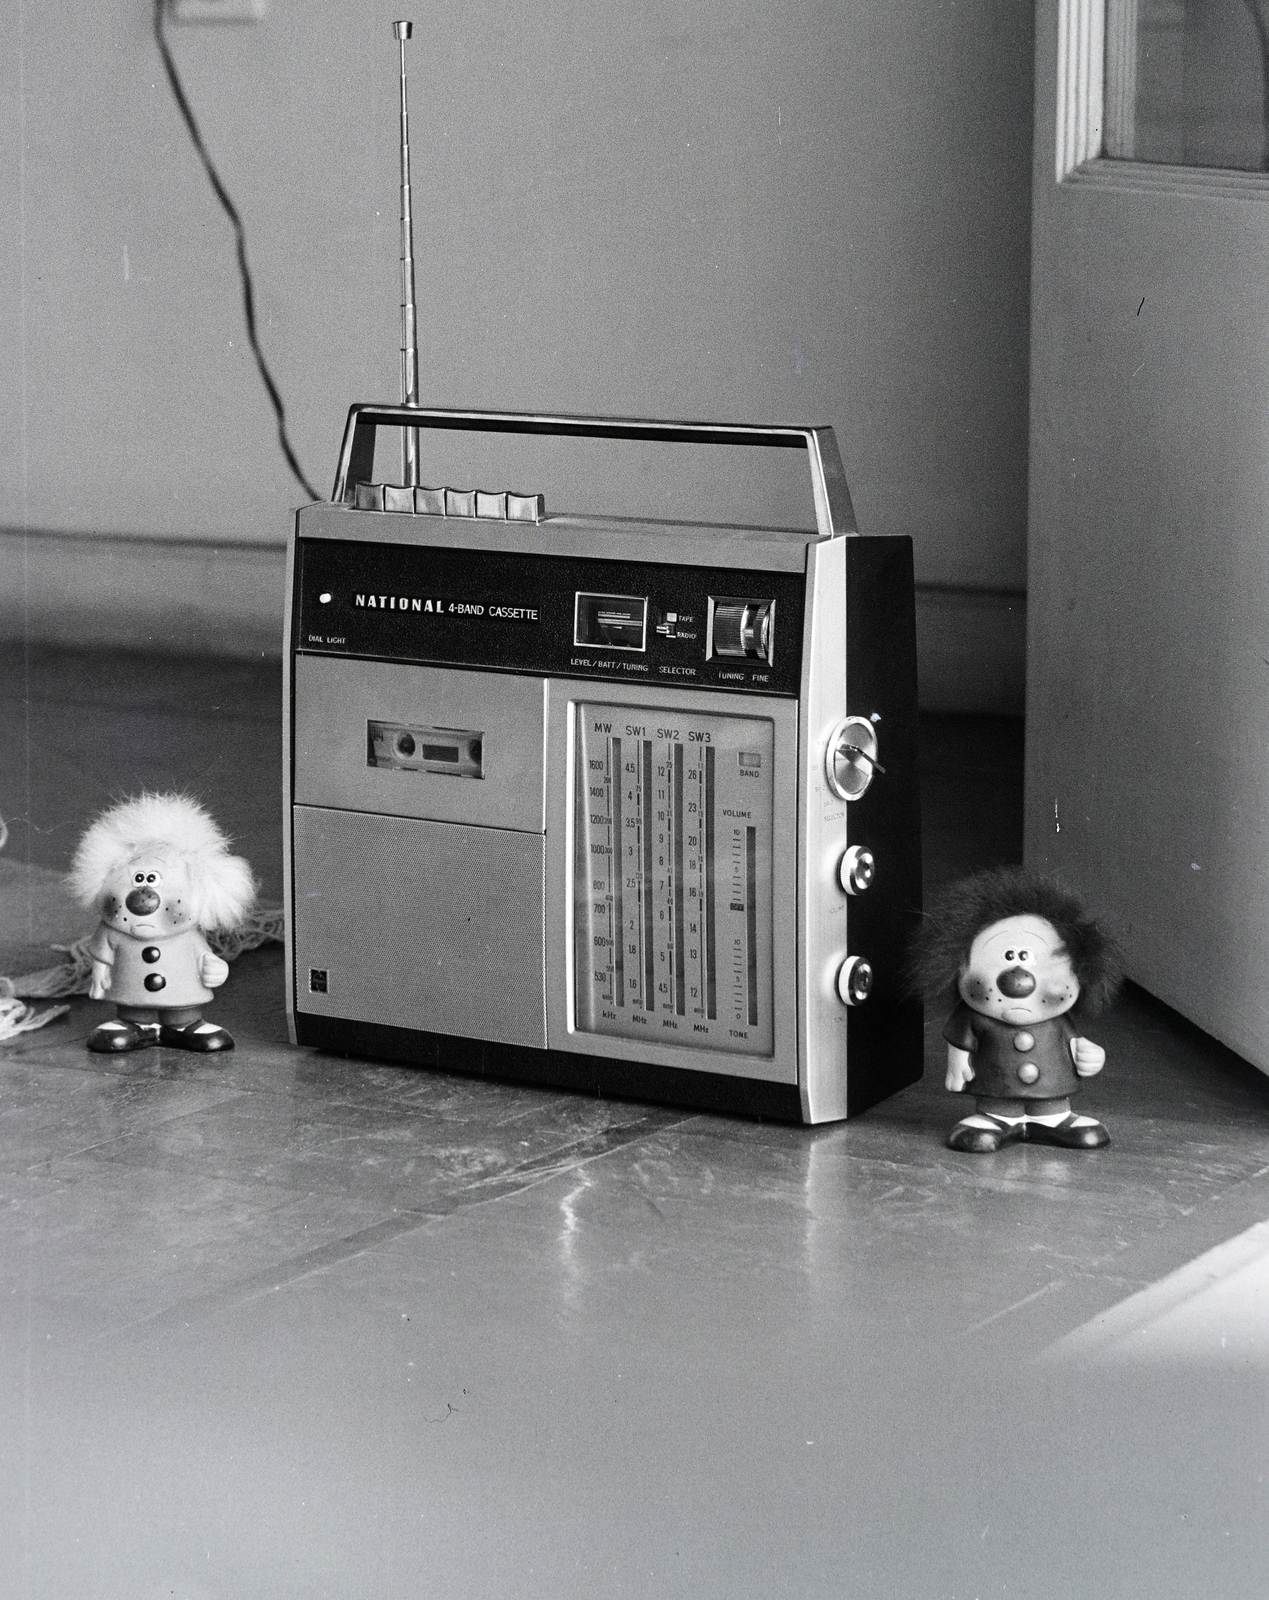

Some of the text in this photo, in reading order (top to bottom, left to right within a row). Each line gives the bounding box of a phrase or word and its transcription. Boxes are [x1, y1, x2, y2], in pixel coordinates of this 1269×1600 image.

[355, 594, 538, 620] NATIONAL 4-BAND CASSETTE
[678, 615, 694, 623] TAPE
[308, 634, 346, 644] DIAL LIGHT
[677, 632, 696, 640] RADIO
[659, 666, 696, 676] SELECTOR
[718, 672, 744, 681] TUNING
[752, 674, 769, 682] FINE
[594, 722, 711, 743] MW SW1 SW2 SW3
[589, 760, 604, 770] 1600
[657, 766, 665, 776] 12
[688, 769, 697, 780] 26
[739, 769, 760, 778] BAND
[627, 790, 632, 800] 4
[658, 790, 665, 799] 11
[688, 802, 697, 813] 23
[590, 814, 604, 824] 1200
[657, 810, 665, 821] 10
[722, 809, 752, 819] VOLUME
[658, 833, 664, 843] 9
[688, 835, 697, 846] 20
[591, 844, 604, 854] 1000
[628, 846, 633, 856] 3
[659, 856, 664, 866] 8
[689, 860, 696, 870] 18
[592, 880, 605, 891] 800
[659, 880, 664, 890] 7
[689, 887, 697, 897] 16
[593, 903, 606, 914] 700
[659, 910, 664, 920] 6
[629, 920, 634, 930] 2
[689, 923, 697, 933] 14
[593, 936, 605, 947] 600
[660, 951, 665, 961] 5
[689, 949, 697, 959] 13
[690, 987, 698, 997] 12
[602, 1010, 709, 1033] kHz MHz MHz MHz
[729, 1029, 748, 1039] TONE
